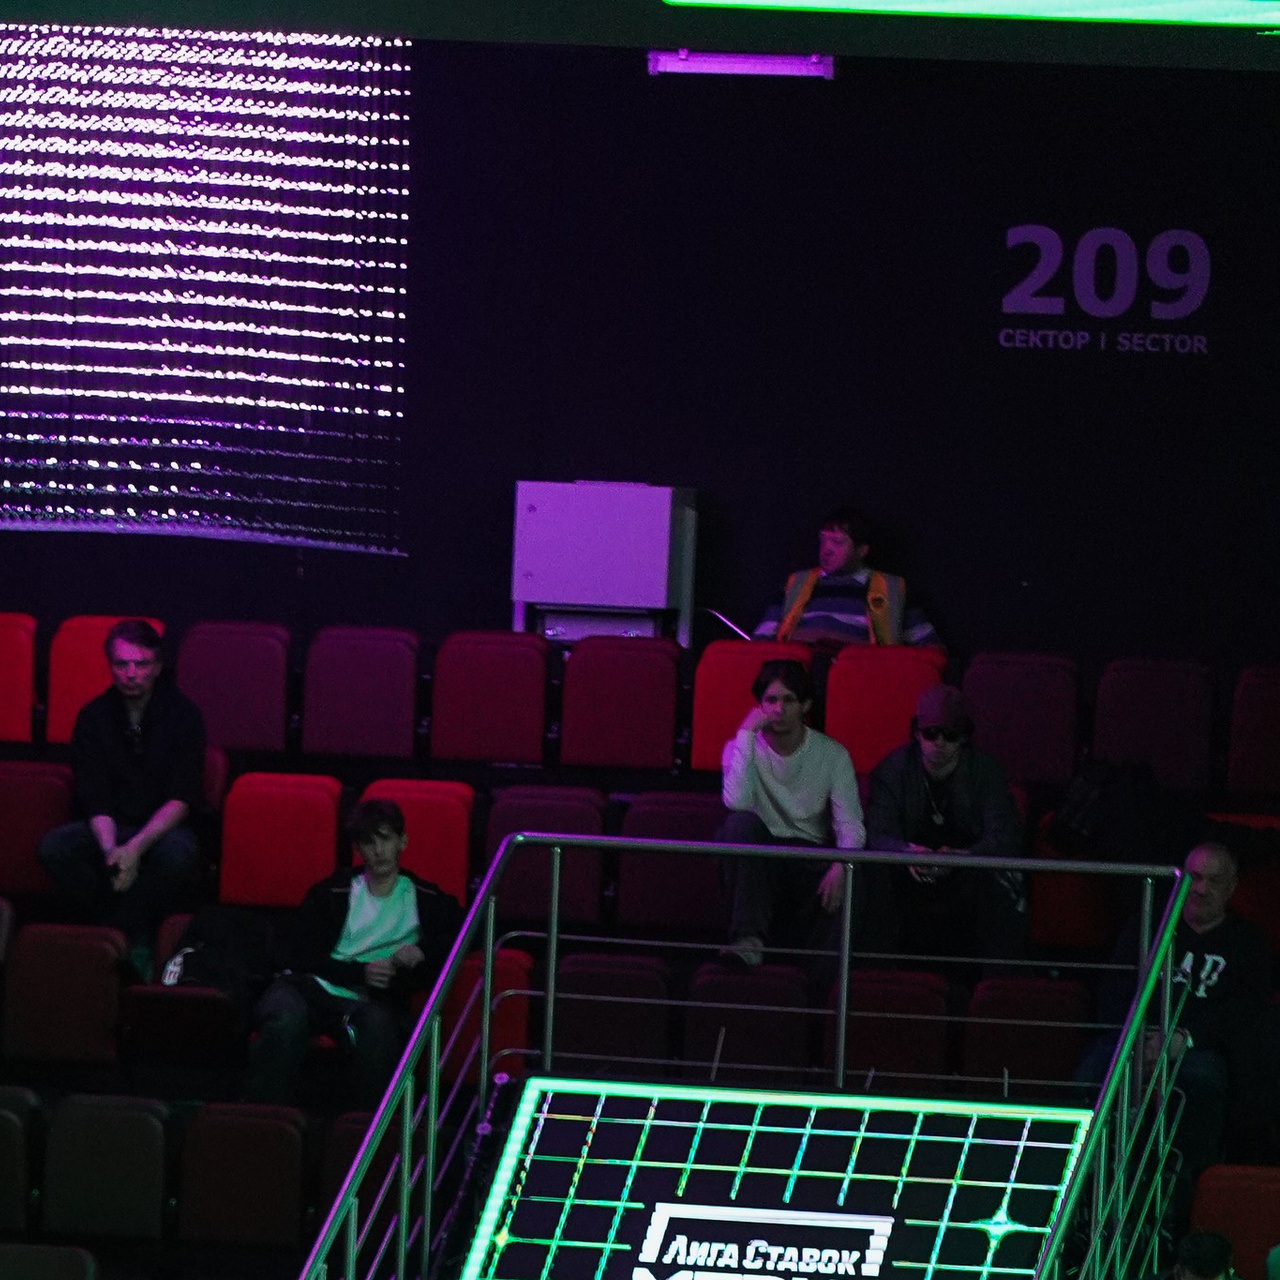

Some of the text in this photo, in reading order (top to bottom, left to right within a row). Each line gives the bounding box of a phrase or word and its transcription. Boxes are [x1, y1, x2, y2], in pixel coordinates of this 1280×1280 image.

[1001, 224, 1211, 320] 209
[998, 328, 1209, 355] СЕКТОР SECTOR
